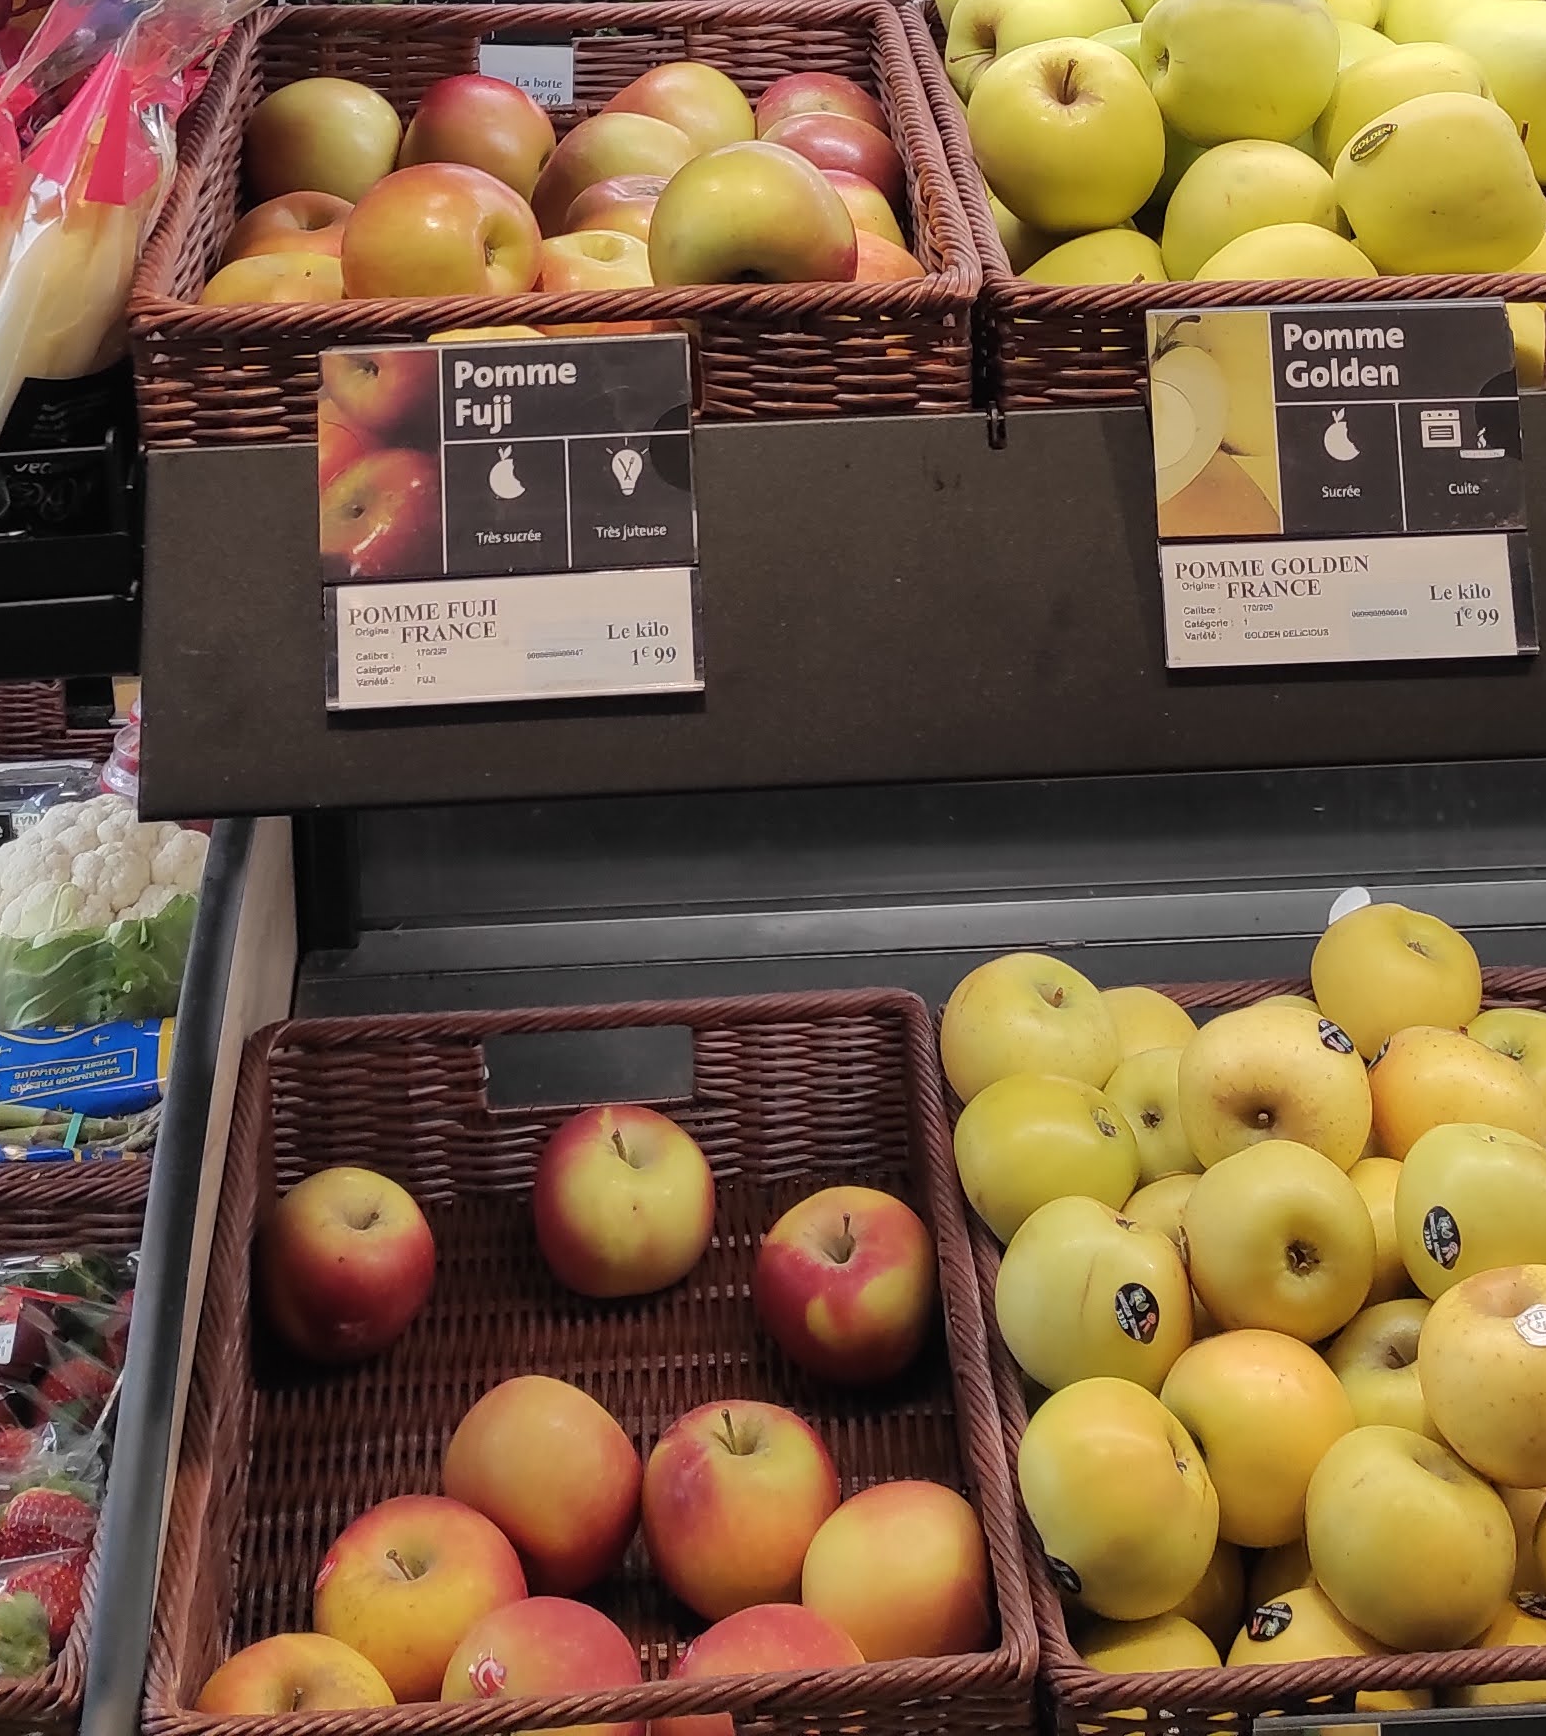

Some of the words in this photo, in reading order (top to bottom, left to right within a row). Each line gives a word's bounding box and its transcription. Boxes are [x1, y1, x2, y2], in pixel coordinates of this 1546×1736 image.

[515, 76, 530, 88] La
[533, 77, 563, 90] botte
[1283, 322, 1405, 352] Pomme
[454, 360, 578, 390] Pomme
[1285, 357, 1400, 389] Golden
[455, 394, 513, 435] Fuji
[1321, 484, 1362, 500] Sucrée
[1448, 482, 1481, 497] Cuite
[475, 530, 502, 545] Très
[503, 529, 542, 544] sucrée
[596, 525, 621, 539] Très
[621, 524, 668, 542] juteuse
[1174, 559, 1266, 580] POMME
[1270, 553, 1370, 576] GOLDEN
[1226, 578, 1323, 601] FRANCE
[1429, 584, 1453, 602] Le
[1457, 581, 1492, 601] kilo
[348, 602, 441, 626] POMME
[447, 598, 498, 619] FUJI
[400, 620, 497, 644] FRANCE
[606, 623, 632, 641] Le
[635, 620, 670, 639] kilo
